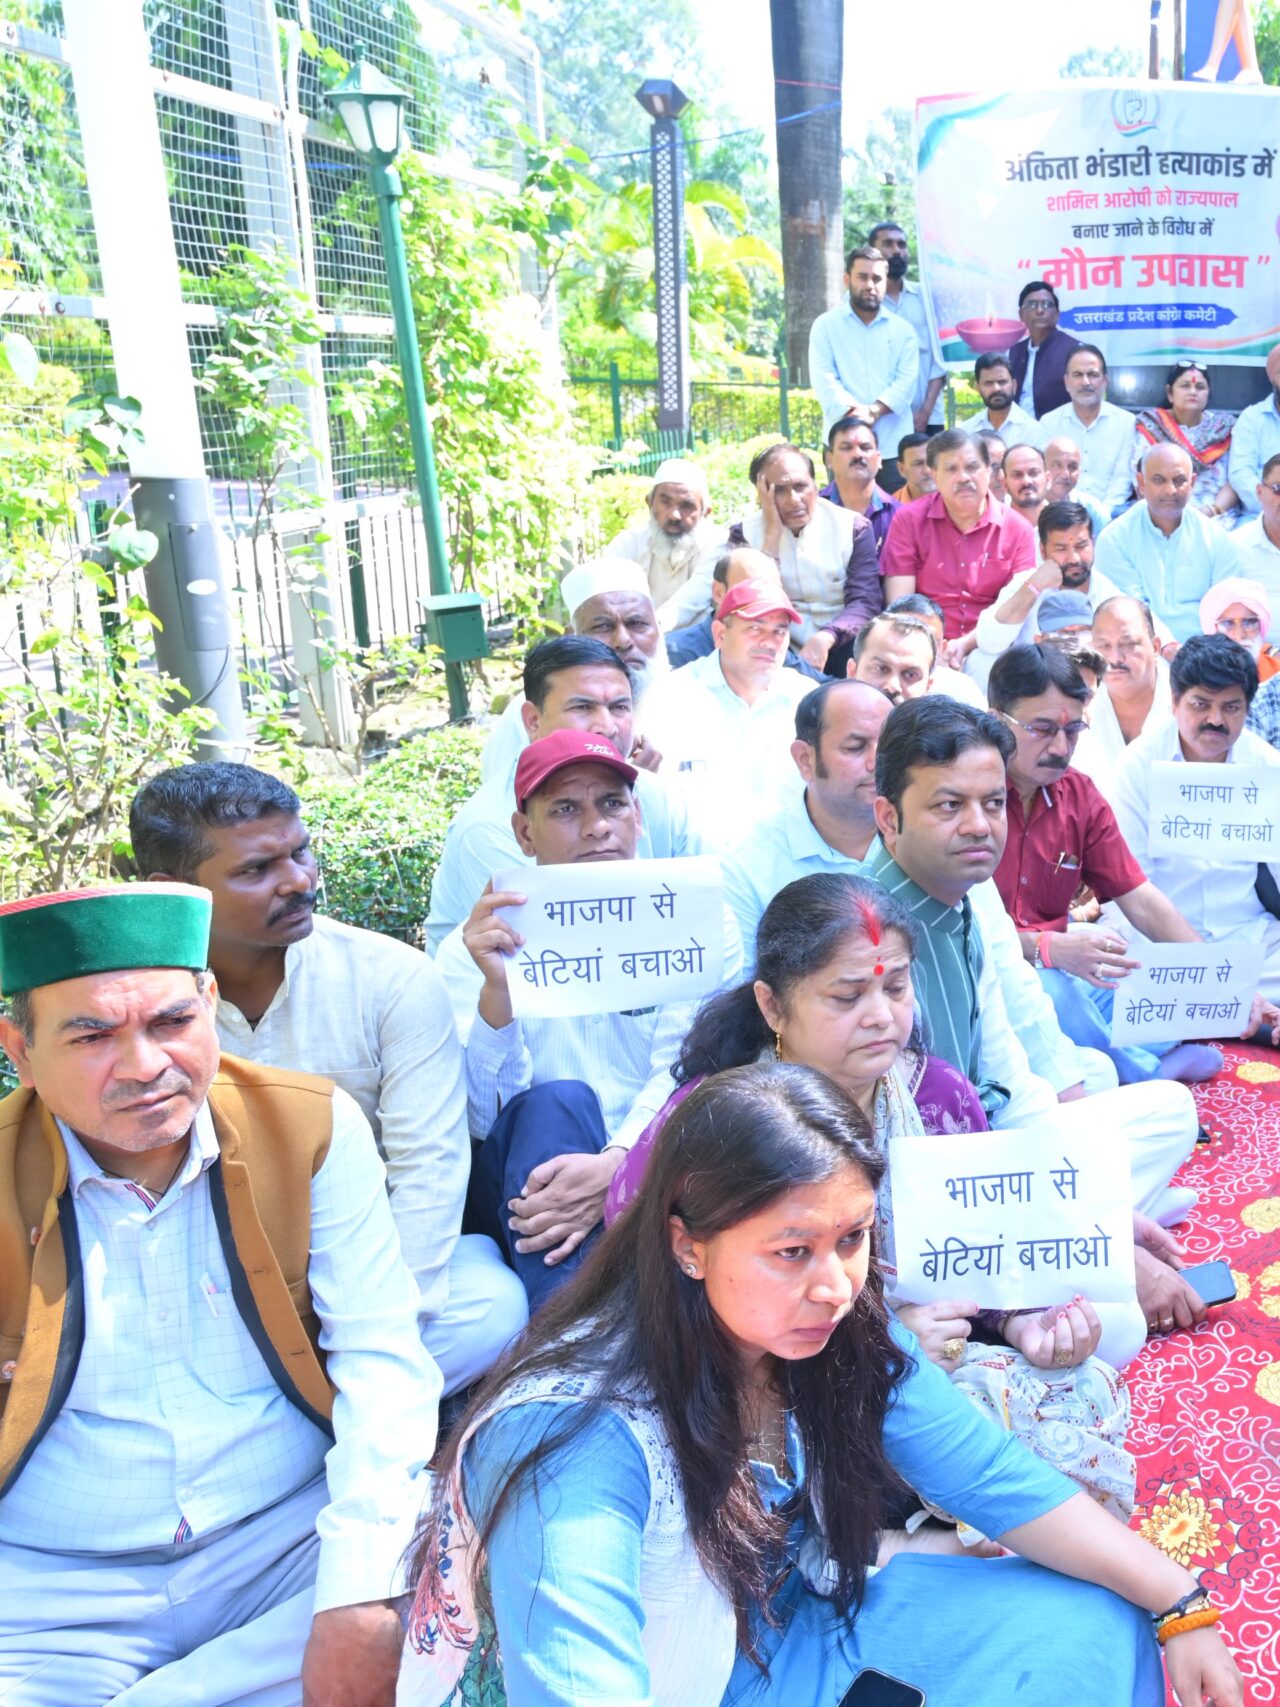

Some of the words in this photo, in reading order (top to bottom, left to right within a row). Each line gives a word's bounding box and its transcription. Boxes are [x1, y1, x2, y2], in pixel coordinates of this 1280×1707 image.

[1005, 151, 1079, 182] अंकिता
[1085, 145, 1152, 178] भंडारी
[1156, 147, 1248, 178] हत्याकांड
[1252, 148, 1278, 178] में
[1047, 190, 1099, 212] शामिल
[1104, 186, 1152, 208] आरोपी
[1155, 185, 1173, 206] को
[1175, 190, 1239, 208] राज्यपाल
[1072, 224, 1110, 239] बनाए
[1112, 217, 1145, 237] जाने
[1147, 217, 1160, 236] के
[1162, 216, 1196, 236] विरोध
[1199, 218, 1216, 236] में
[1073, 309, 1125, 324] उत्तराखंड
[1128, 307, 1155, 323] प्रदेश
[1184, 306, 1217, 321] कमेटी
[1180, 784, 1234, 804] भाजपा
[1242, 781, 1259, 804] से
[1161, 814, 1212, 840] बेटियां
[1221, 818, 1274, 842] बचाओ
[544, 896, 636, 927] भाजपा
[650, 883, 677, 919] से
[519, 948, 603, 988] बेटियां
[618, 937, 706, 979] बचाओ
[1149, 966, 1207, 984] भाजपा
[1216, 958, 1233, 983] से
[1125, 998, 1177, 1025] बेटियां
[1185, 996, 1241, 1020] बचाओ
[945, 1171, 1035, 1208] भाजपा
[1049, 1156, 1079, 1200] से
[919, 1233, 1004, 1282] बेटियां
[1016, 1224, 1112, 1271] बचाओ
